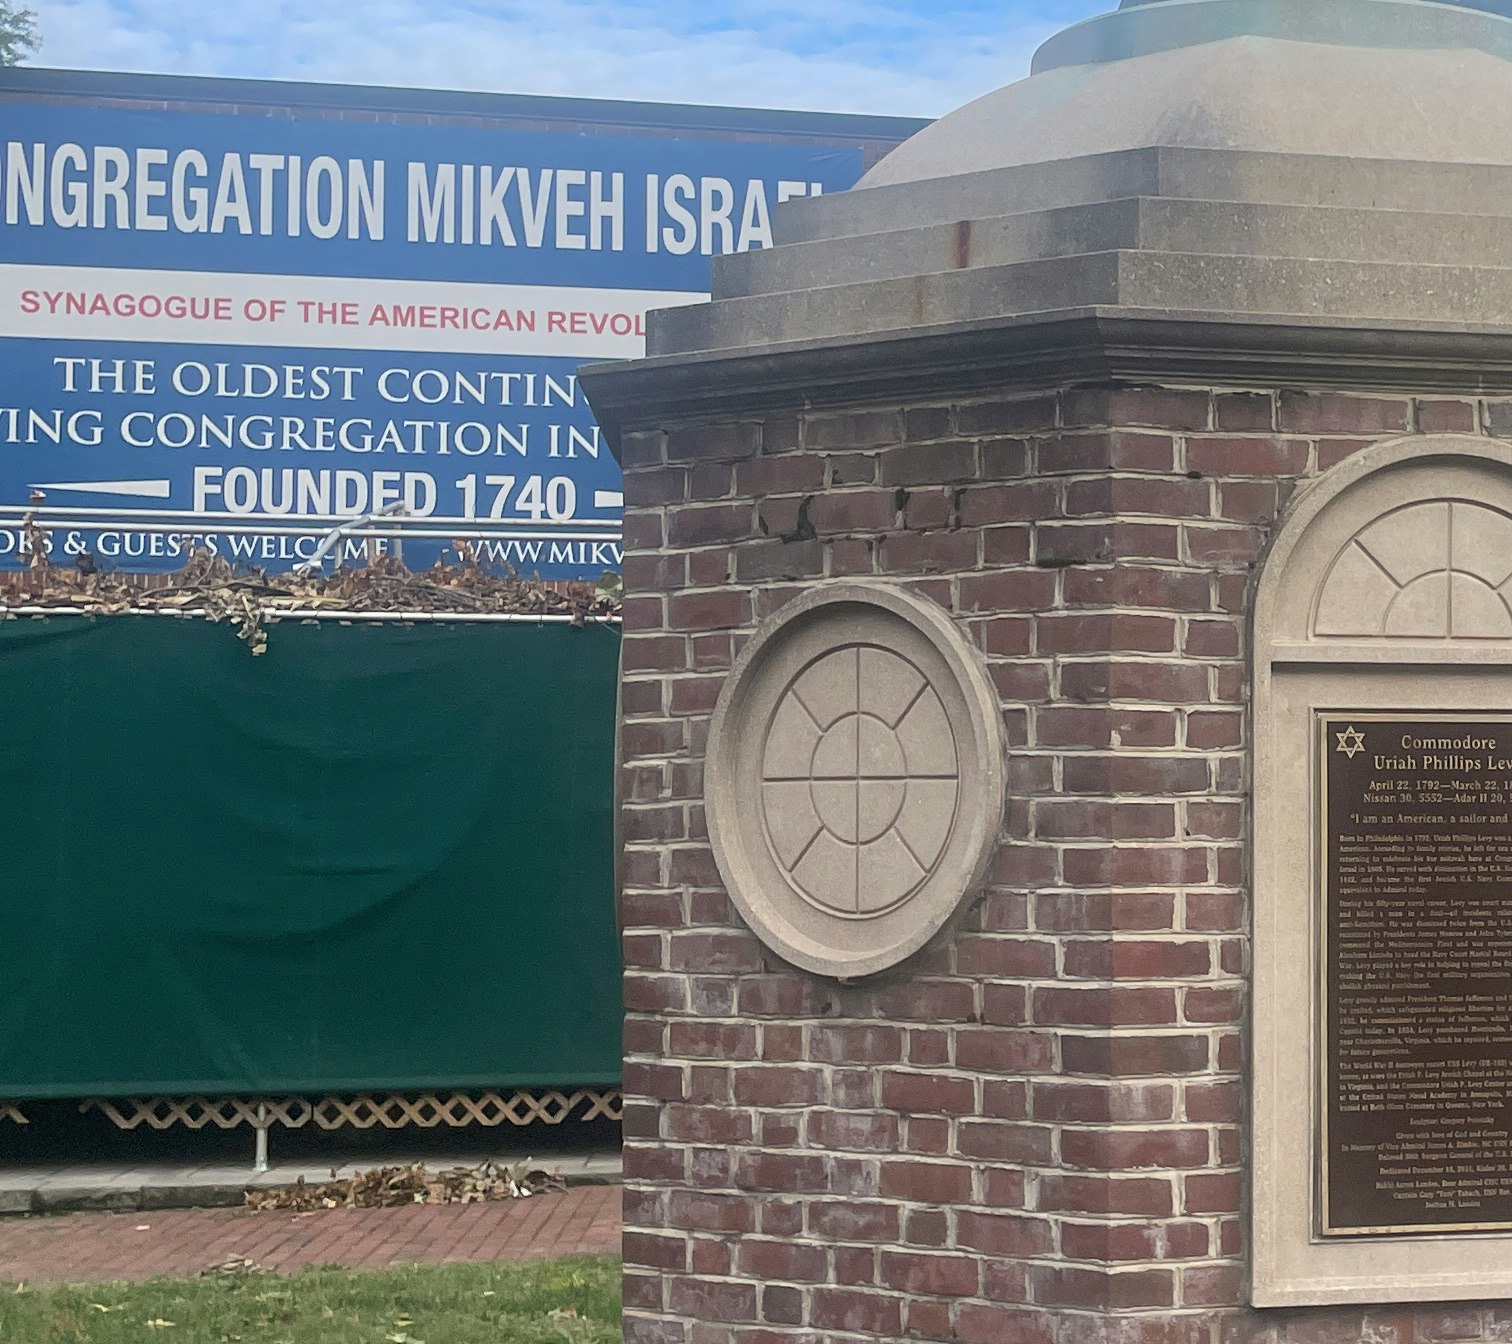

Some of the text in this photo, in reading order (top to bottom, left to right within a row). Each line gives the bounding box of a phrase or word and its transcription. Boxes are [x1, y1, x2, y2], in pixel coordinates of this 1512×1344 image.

[407, 161, 624, 252] MIKVEH
[646, 173, 823, 256] ISRA
[20, 289, 233, 321] SYNAGOGUE
[243, 298, 287, 323] OF
[297, 301, 359, 326] THE
[367, 303, 535, 332] AMERICAN
[53, 357, 590, 408] THE OLDEST CONTIN
[0, 408, 105, 446] ING
[119, 411, 530, 457] CONGREGATION
[193, 466, 577, 520] FOUNDED 1740
[63, 531, 87, 555] &
[97, 532, 218, 558] GUESTS
[1401, 734, 1496, 749] Commodore
[1374, 755, 1417, 770] Uriah
[1423, 755, 1482, 773] Phillips
[1363, 793, 1396, 803] Nissan
[1479, 793, 1487, 803] II
[1490, 793, 1505, 803] 20,
[1369, 780, 1393, 790] April
[1484, 780, 1499, 790] 22,
[1381, 815, 1393, 823] an
[1459, 814, 1486, 822] sailor
